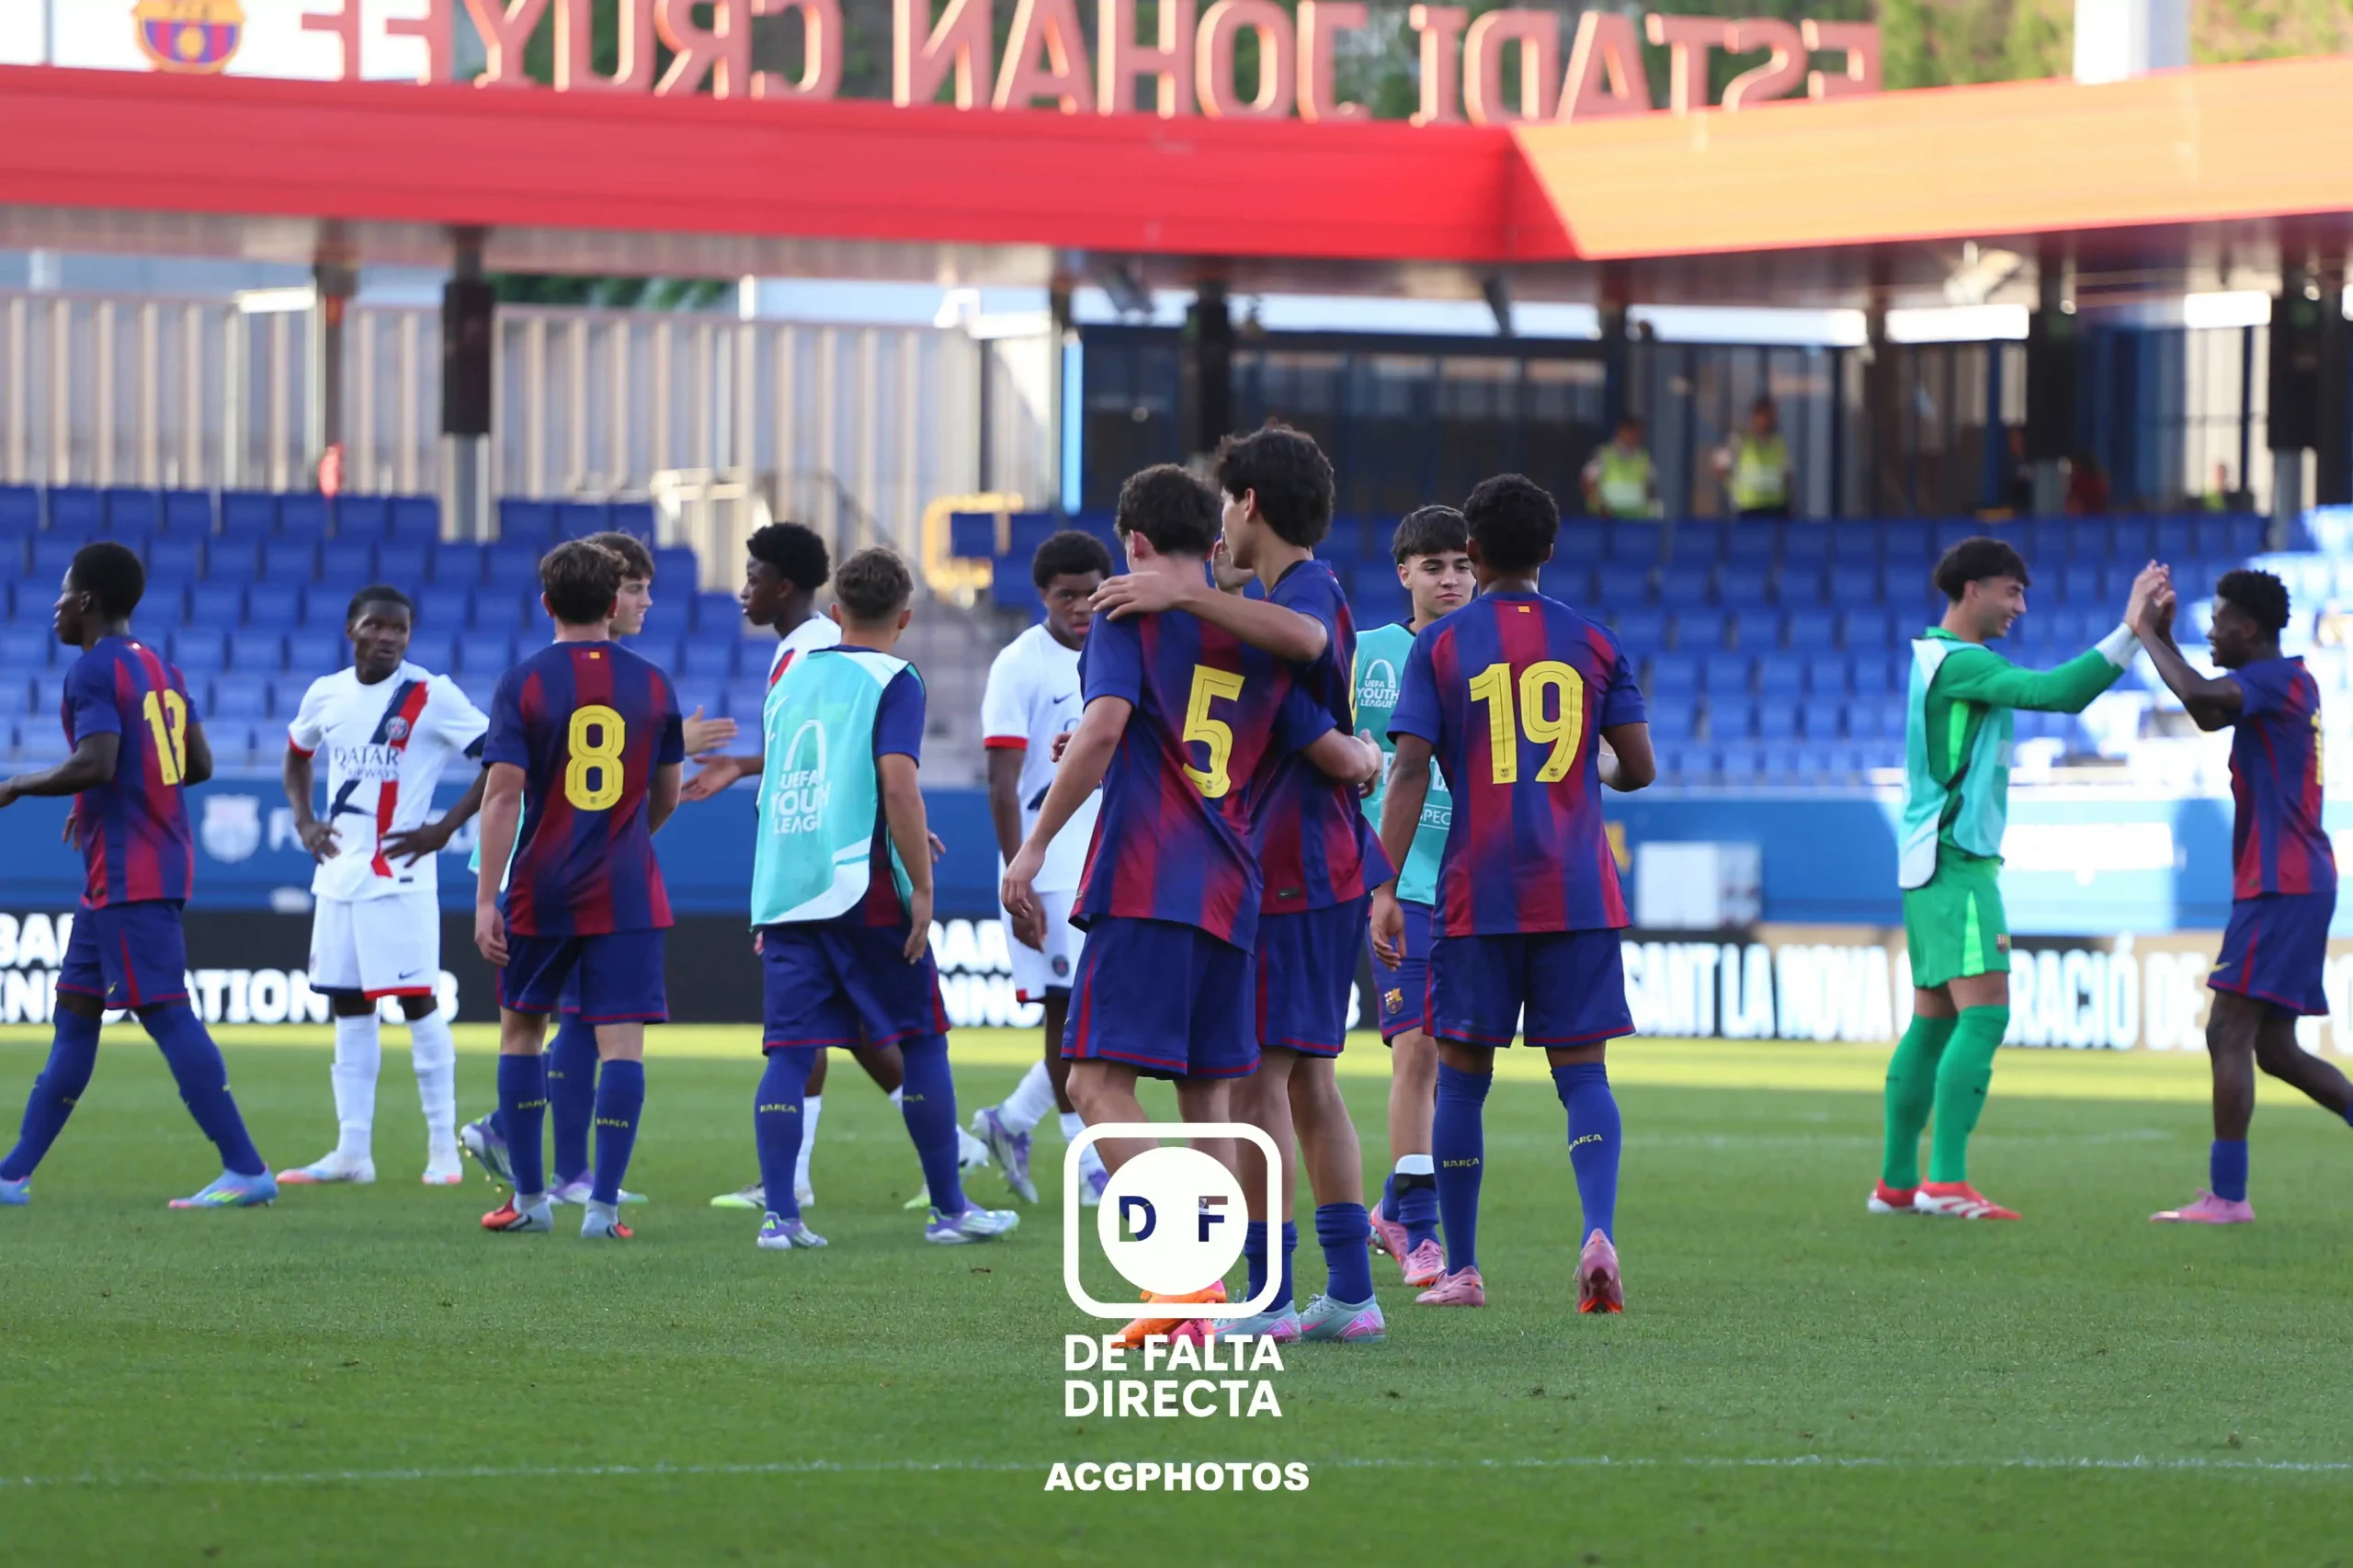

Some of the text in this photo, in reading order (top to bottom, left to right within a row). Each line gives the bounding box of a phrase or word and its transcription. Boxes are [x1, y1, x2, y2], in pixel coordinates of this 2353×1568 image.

[1357, 687, 1399, 700] YOUTH
[1365, 680, 1385, 688] UEFA
[1360, 699, 1392, 708] LEAGUE
[1182, 664, 1245, 798] 5
[1470, 660, 1584, 784] 19
[335, 745, 399, 768] QATAR
[564, 704, 625, 811] 8
[779, 769, 819, 790] UEFA
[1443, 1157, 1480, 1169] BARÇA
